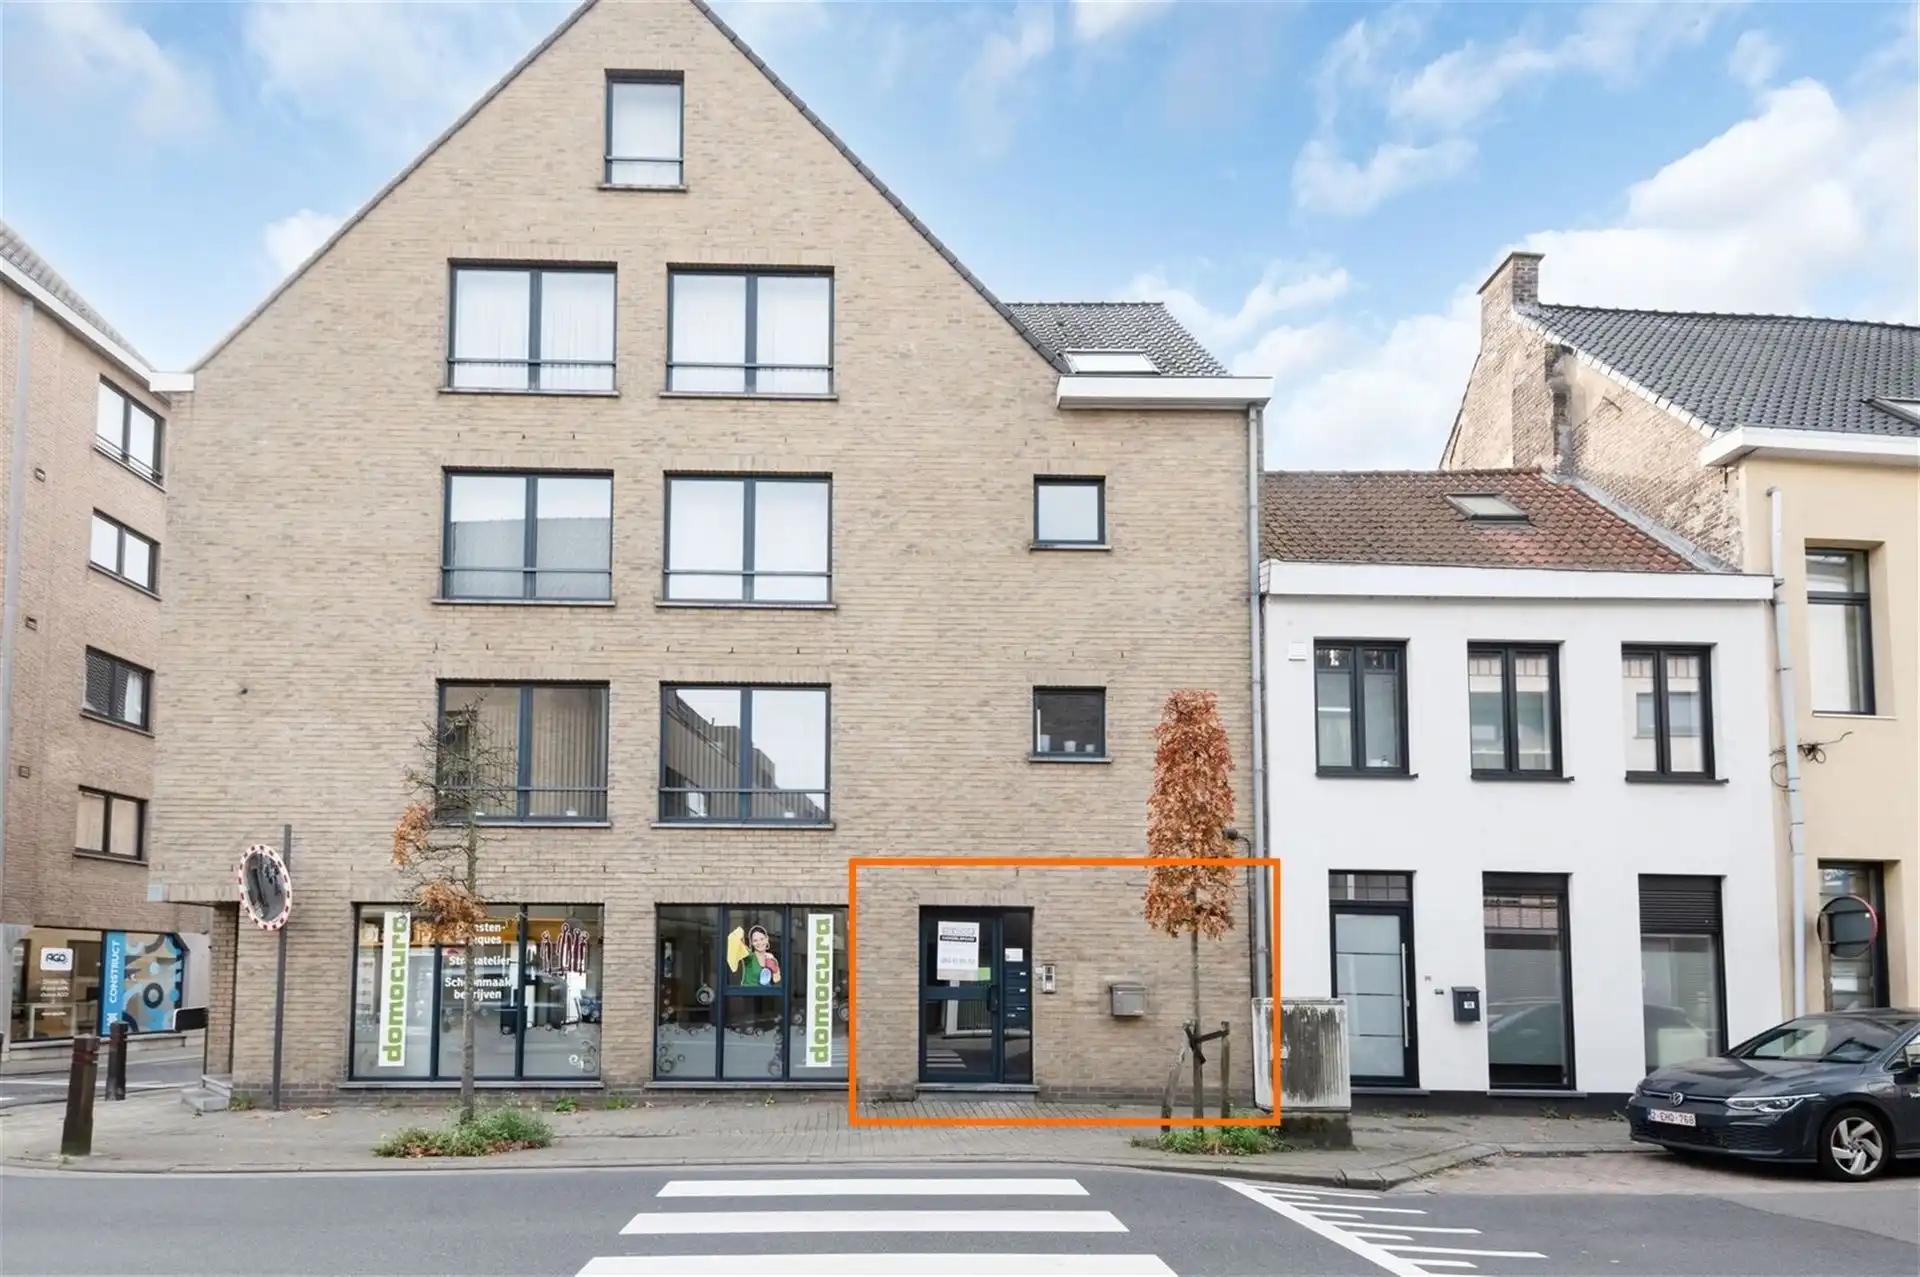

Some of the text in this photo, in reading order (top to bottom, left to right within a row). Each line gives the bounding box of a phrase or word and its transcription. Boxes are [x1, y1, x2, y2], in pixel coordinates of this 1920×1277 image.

[383, 915, 408, 1061] domocura
[445, 977, 512, 987] Schnmaak
[454, 990, 502, 1001] berijven
[809, 919, 830, 1062] domocura
